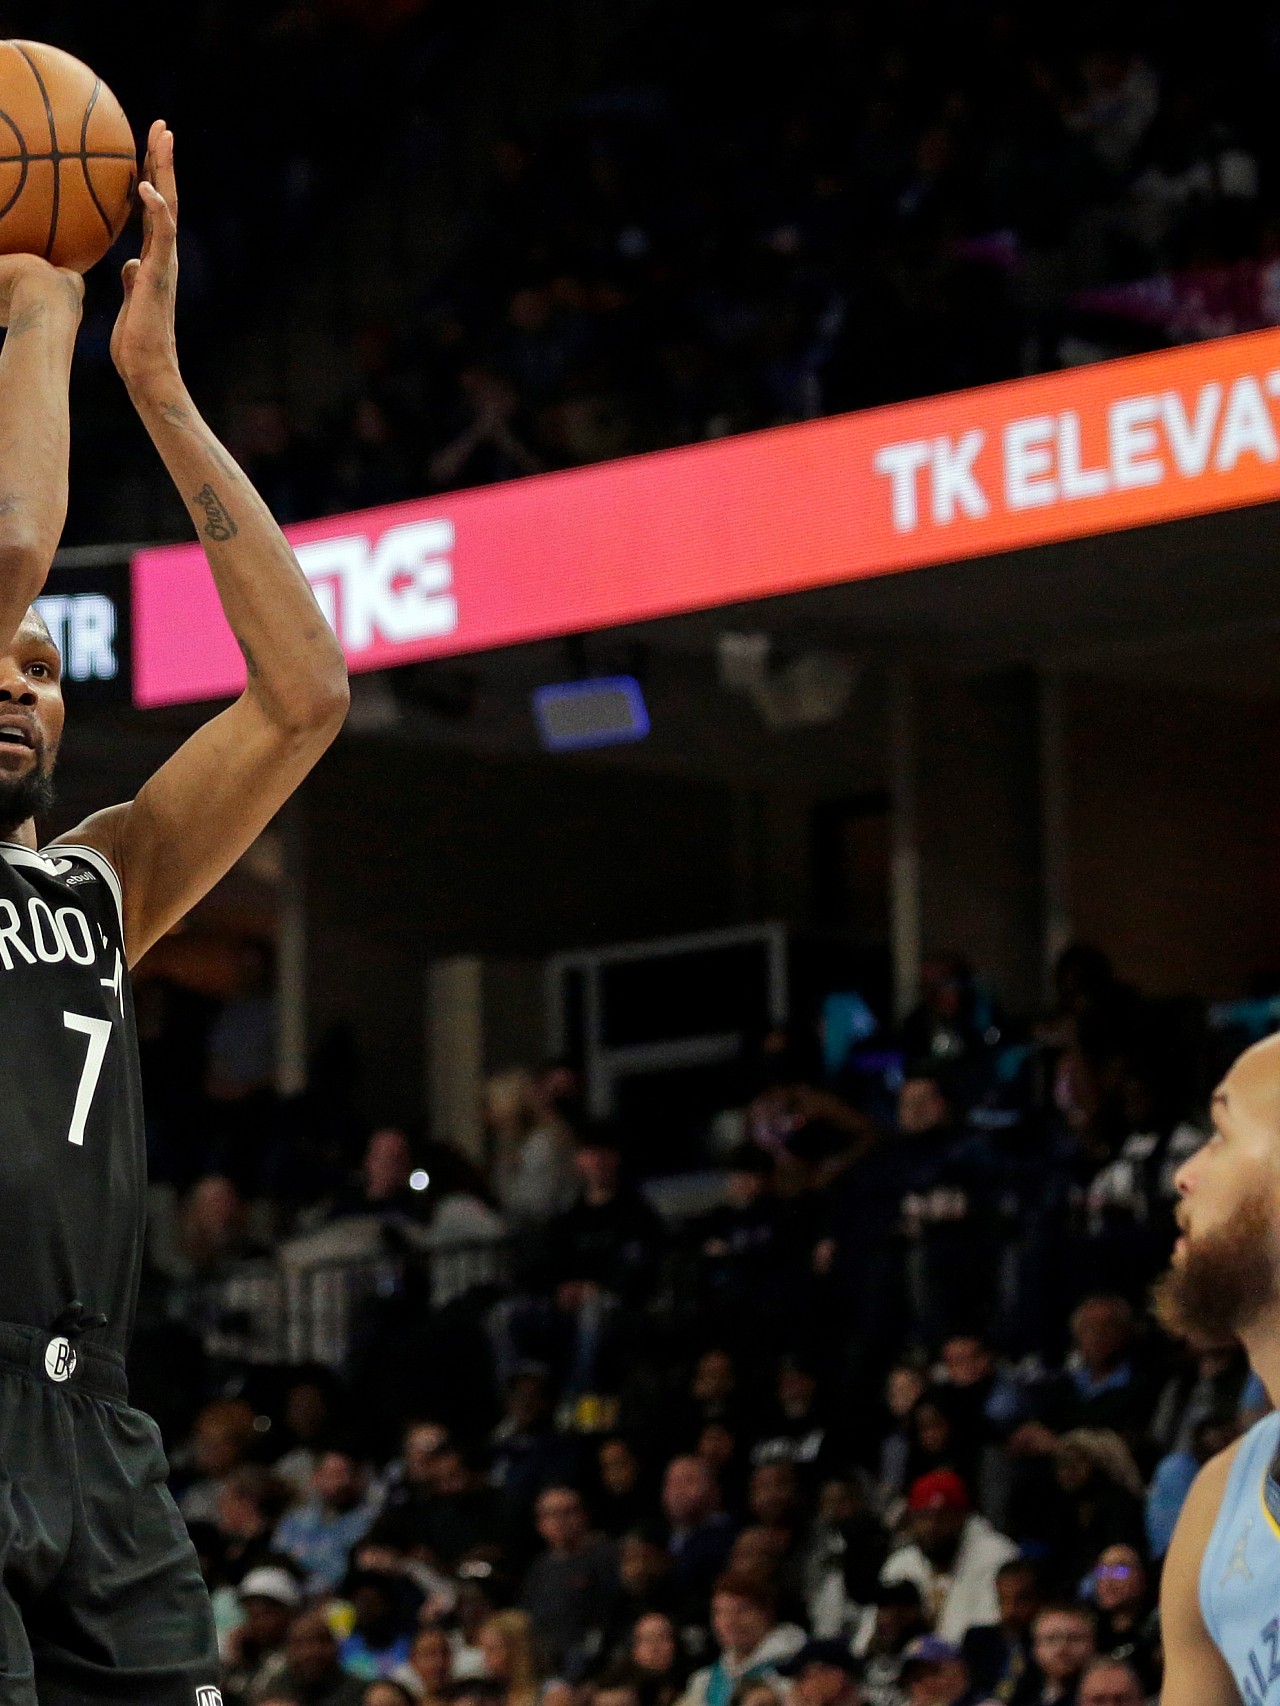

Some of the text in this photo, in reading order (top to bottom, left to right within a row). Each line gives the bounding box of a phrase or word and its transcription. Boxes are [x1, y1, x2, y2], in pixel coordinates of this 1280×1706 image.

[874, 427, 990, 534] TK
[28, 593, 119, 682] TR
[65, 870, 97, 888] ebull
[62, 1010, 113, 1146] 7
